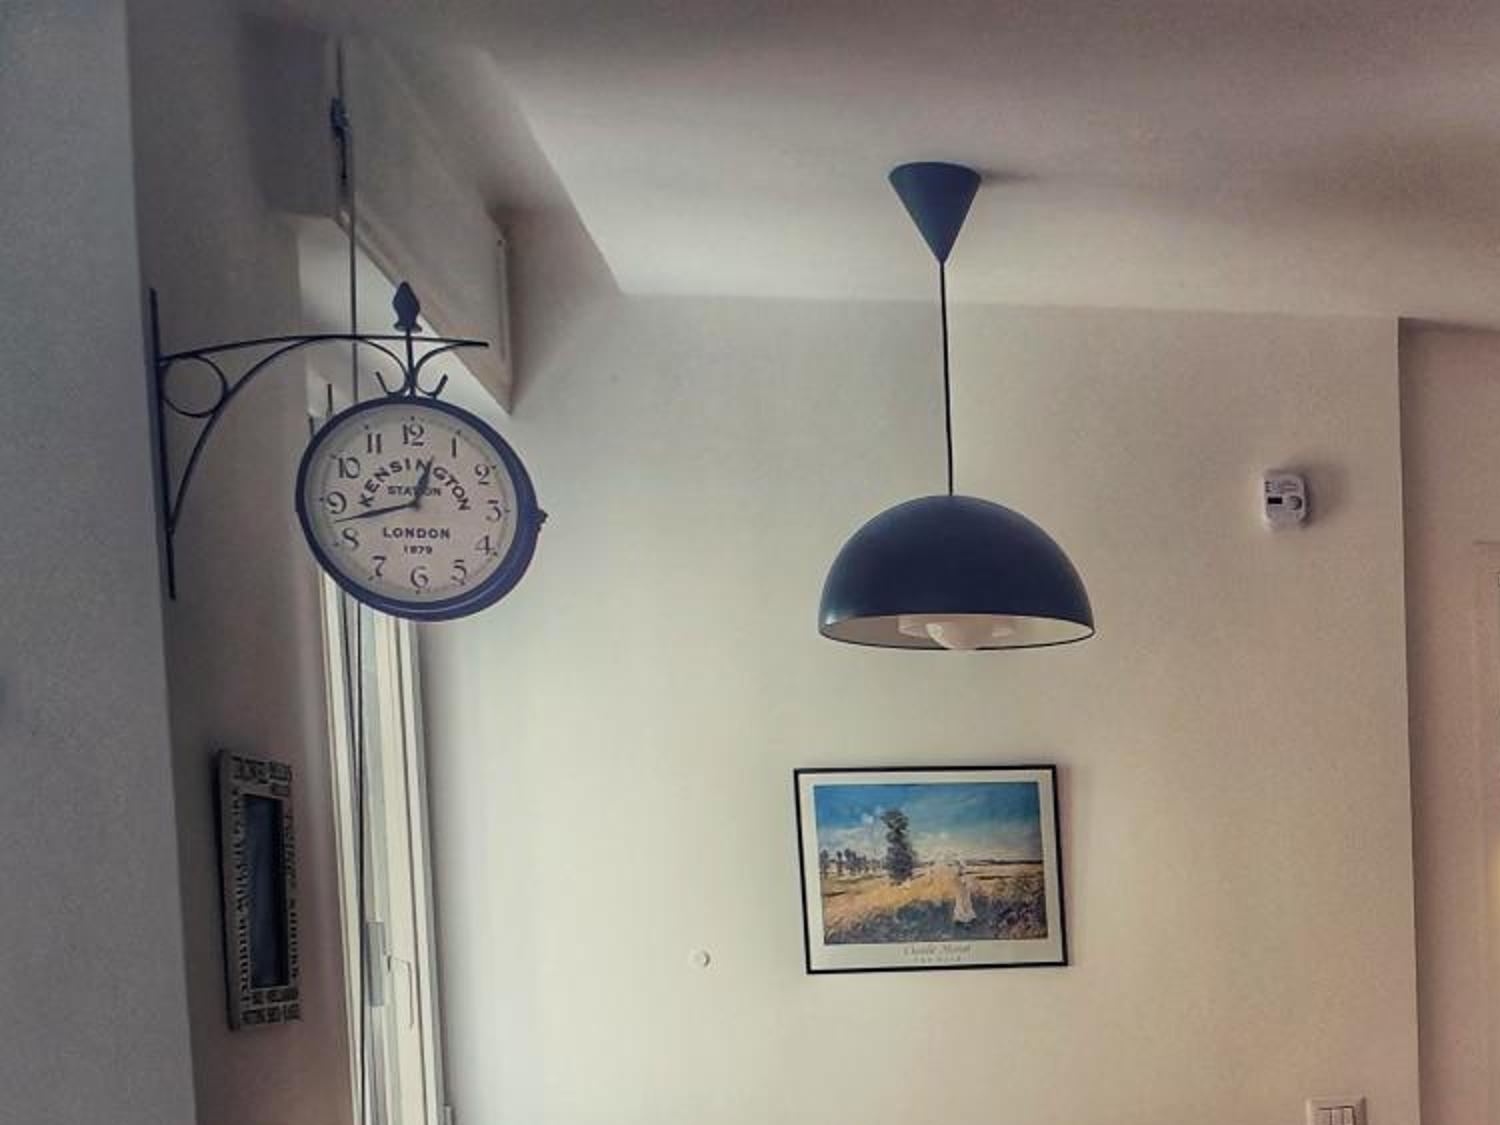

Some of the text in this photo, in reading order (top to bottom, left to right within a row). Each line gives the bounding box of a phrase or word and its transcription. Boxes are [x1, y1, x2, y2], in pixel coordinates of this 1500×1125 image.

[366, 432, 383, 454] 11
[402, 423, 425, 447] 12
[450, 437, 458, 458] 1
[337, 457, 362, 479] 10
[474, 463, 491, 486] 2
[357, 456, 472, 512] KENSINGTON
[387, 485, 442, 497] STAON
[326, 491, 347, 515] 9
[485, 499, 503, 522] 3
[342, 527, 360, 550] 8
[383, 527, 450, 539] LONDON
[475, 535, 495, 556] 4
[373, 555, 387, 577] 7
[410, 566, 430, 589] 6
[451, 559, 468, 582] 5
